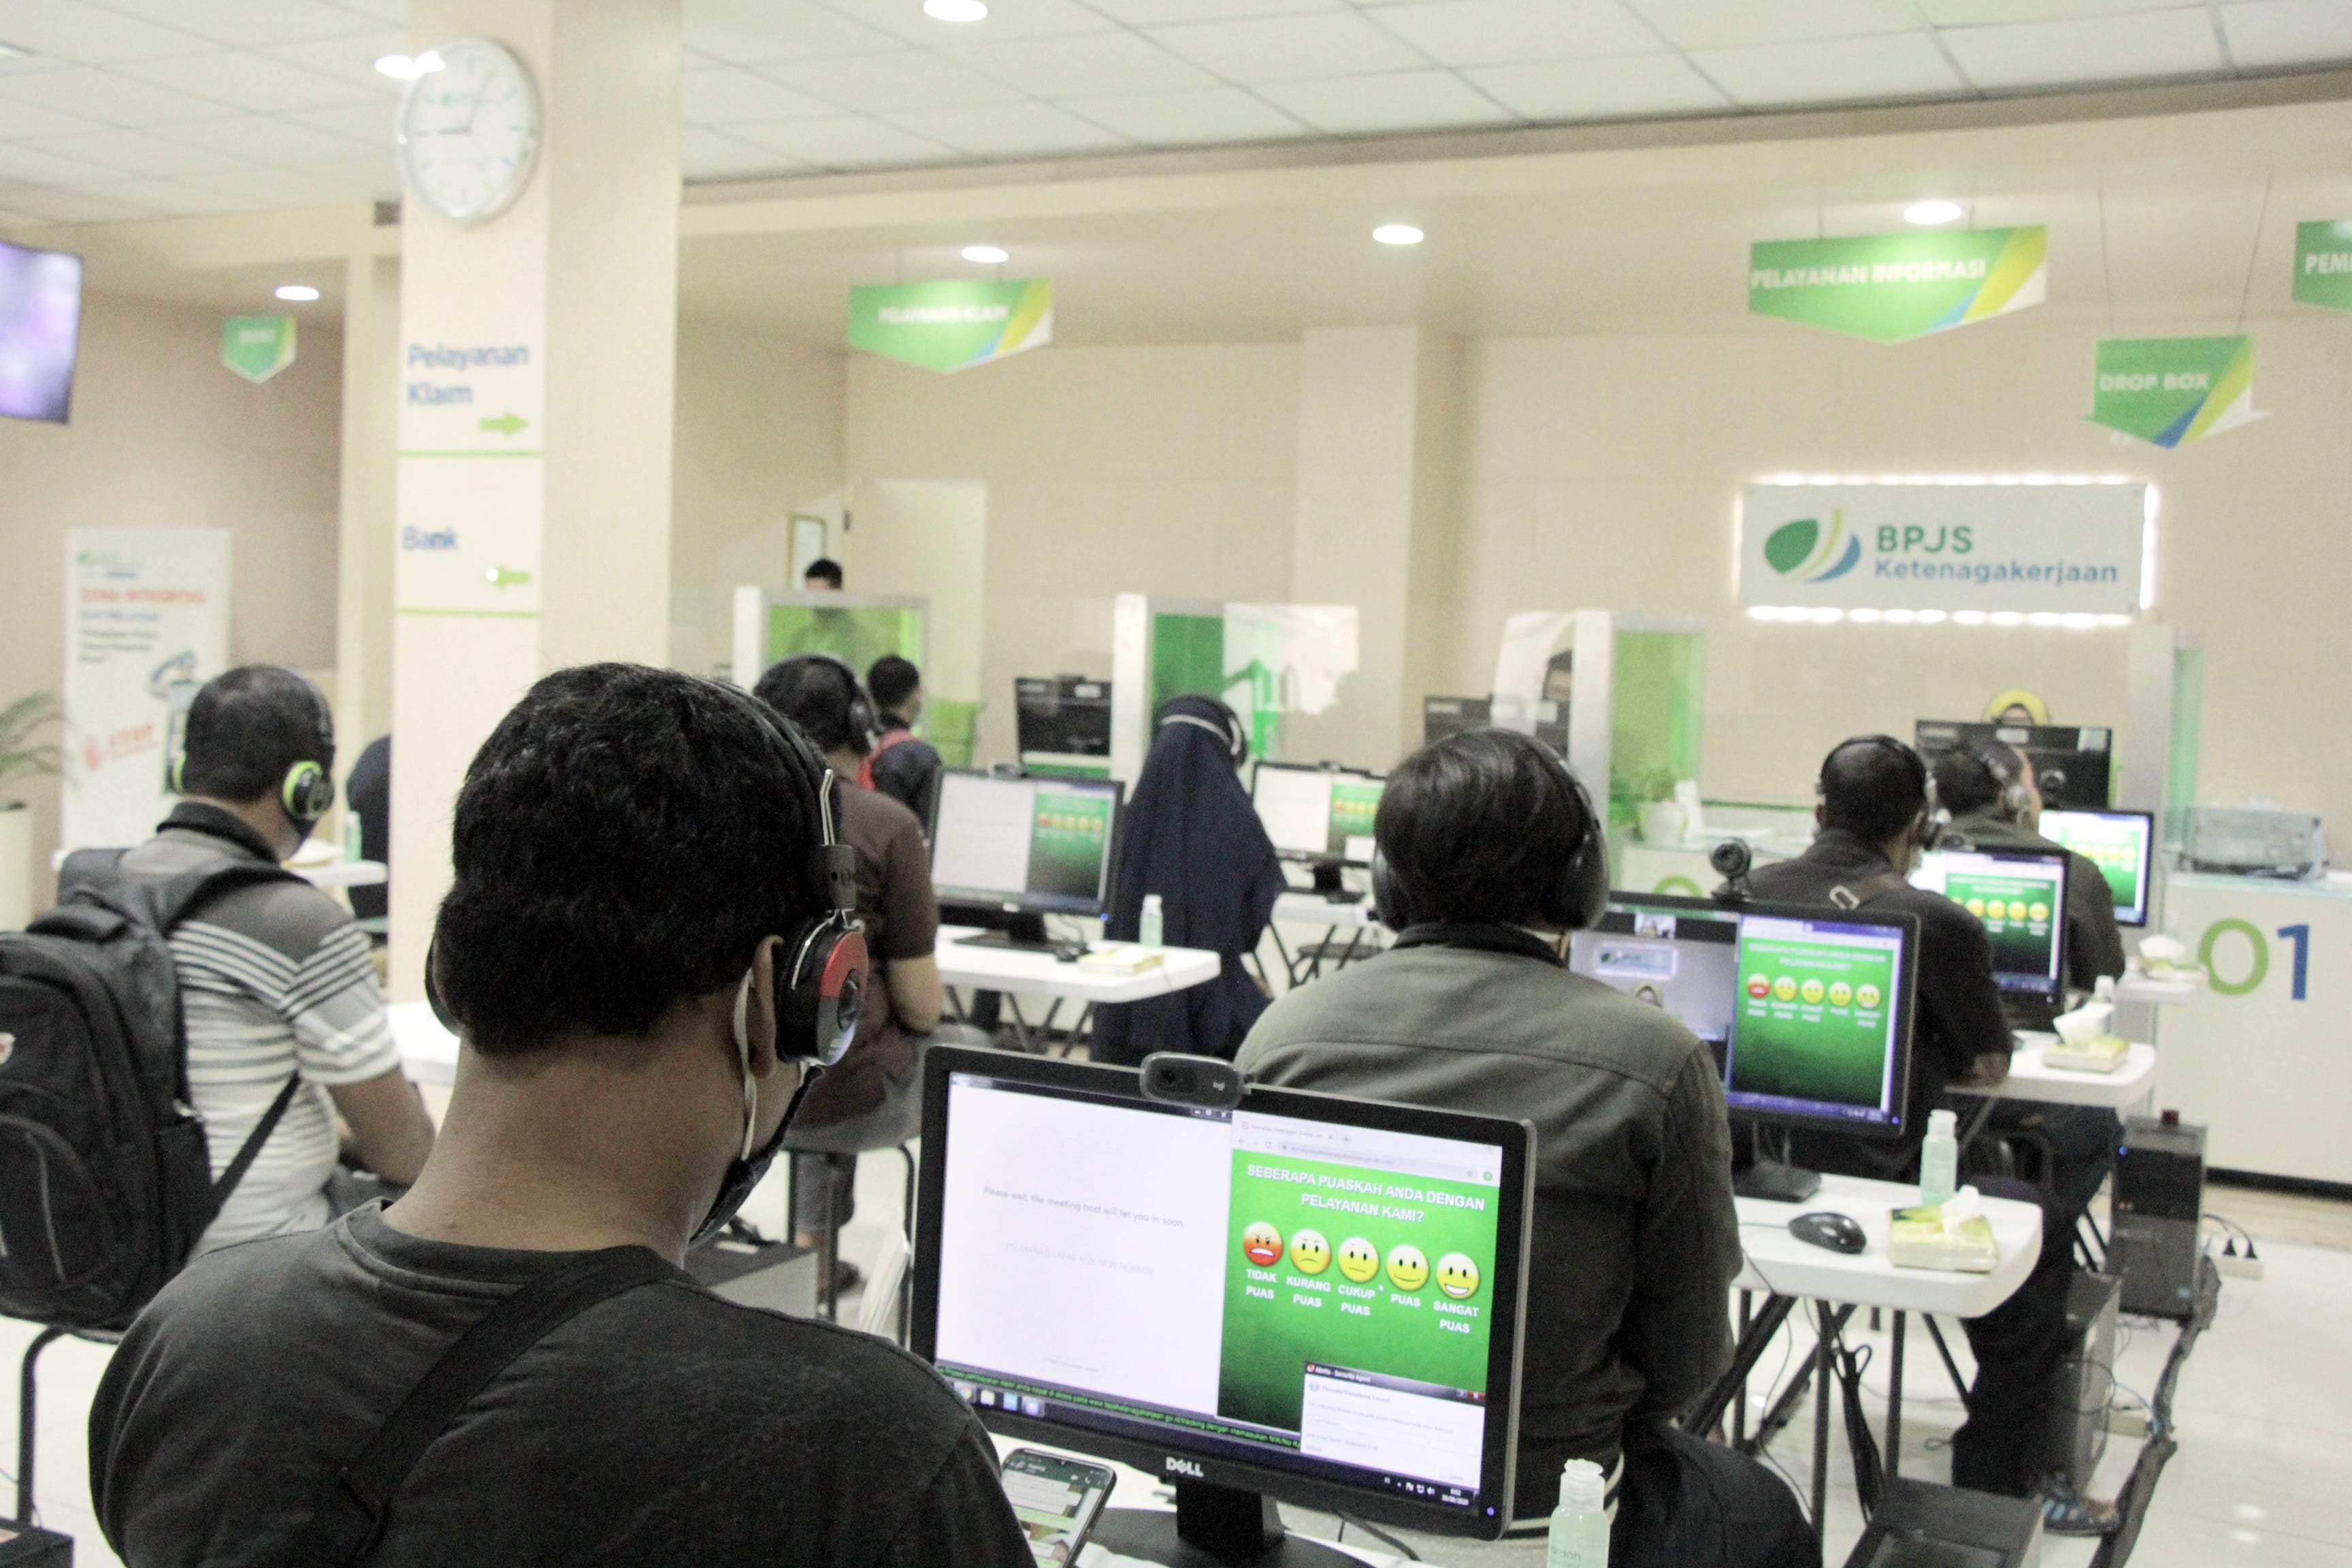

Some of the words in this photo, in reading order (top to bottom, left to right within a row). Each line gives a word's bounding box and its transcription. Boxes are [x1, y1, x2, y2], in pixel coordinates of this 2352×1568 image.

[1752, 265, 1868, 289] PELAYANAN
[1872, 259, 1987, 283] INFORMASI
[2305, 253, 2352, 275] PEM
[408, 344, 529, 371] Pelayanan
[2100, 374, 2158, 391] DROP
[2163, 373, 2210, 390] BOX
[408, 382, 473, 404] Klaim
[403, 526, 459, 550] Bank
[1876, 525, 1973, 554] BPJS
[1874, 559, 2117, 586] Ketenagakerjaan
[1247, 1165, 1316, 1186] SEBERAPA
[1319, 1175, 1382, 1195] PUASKAH
[1386, 1186, 1424, 1202] ANDA
[1426, 1191, 1485, 1210] DENGAN
[984, 1186, 1008, 1198] Please
[1031, 1195, 1044, 1204] the
[1047, 1198, 1081, 1212] meeting
[1083, 1203, 1101, 1213] host
[1104, 1207, 1117, 1216] will
[1120, 1209, 1130, 1218] let
[1133, 1213, 1149, 1223] you
[1152, 1215, 1160, 1224] in
[1301, 1193, 1379, 1216] PELAYANAN
[1382, 1205, 1424, 1222] KAMI?
[1246, 1269, 1277, 1284] TIDAK
[1286, 1277, 1331, 1292] KURANG
[1245, 1286, 1274, 1300] PUAS
[1292, 1294, 1322, 1307] PUAS
[1338, 1285, 1376, 1299] CUKUP
[1390, 1294, 1421, 1307] PUAS
[1341, 1303, 1371, 1316] PUAS
[1433, 1301, 1479, 1318] SANGAT
[1439, 1320, 1470, 1334] PUAS
[1166, 1456, 1204, 1477] DELL
